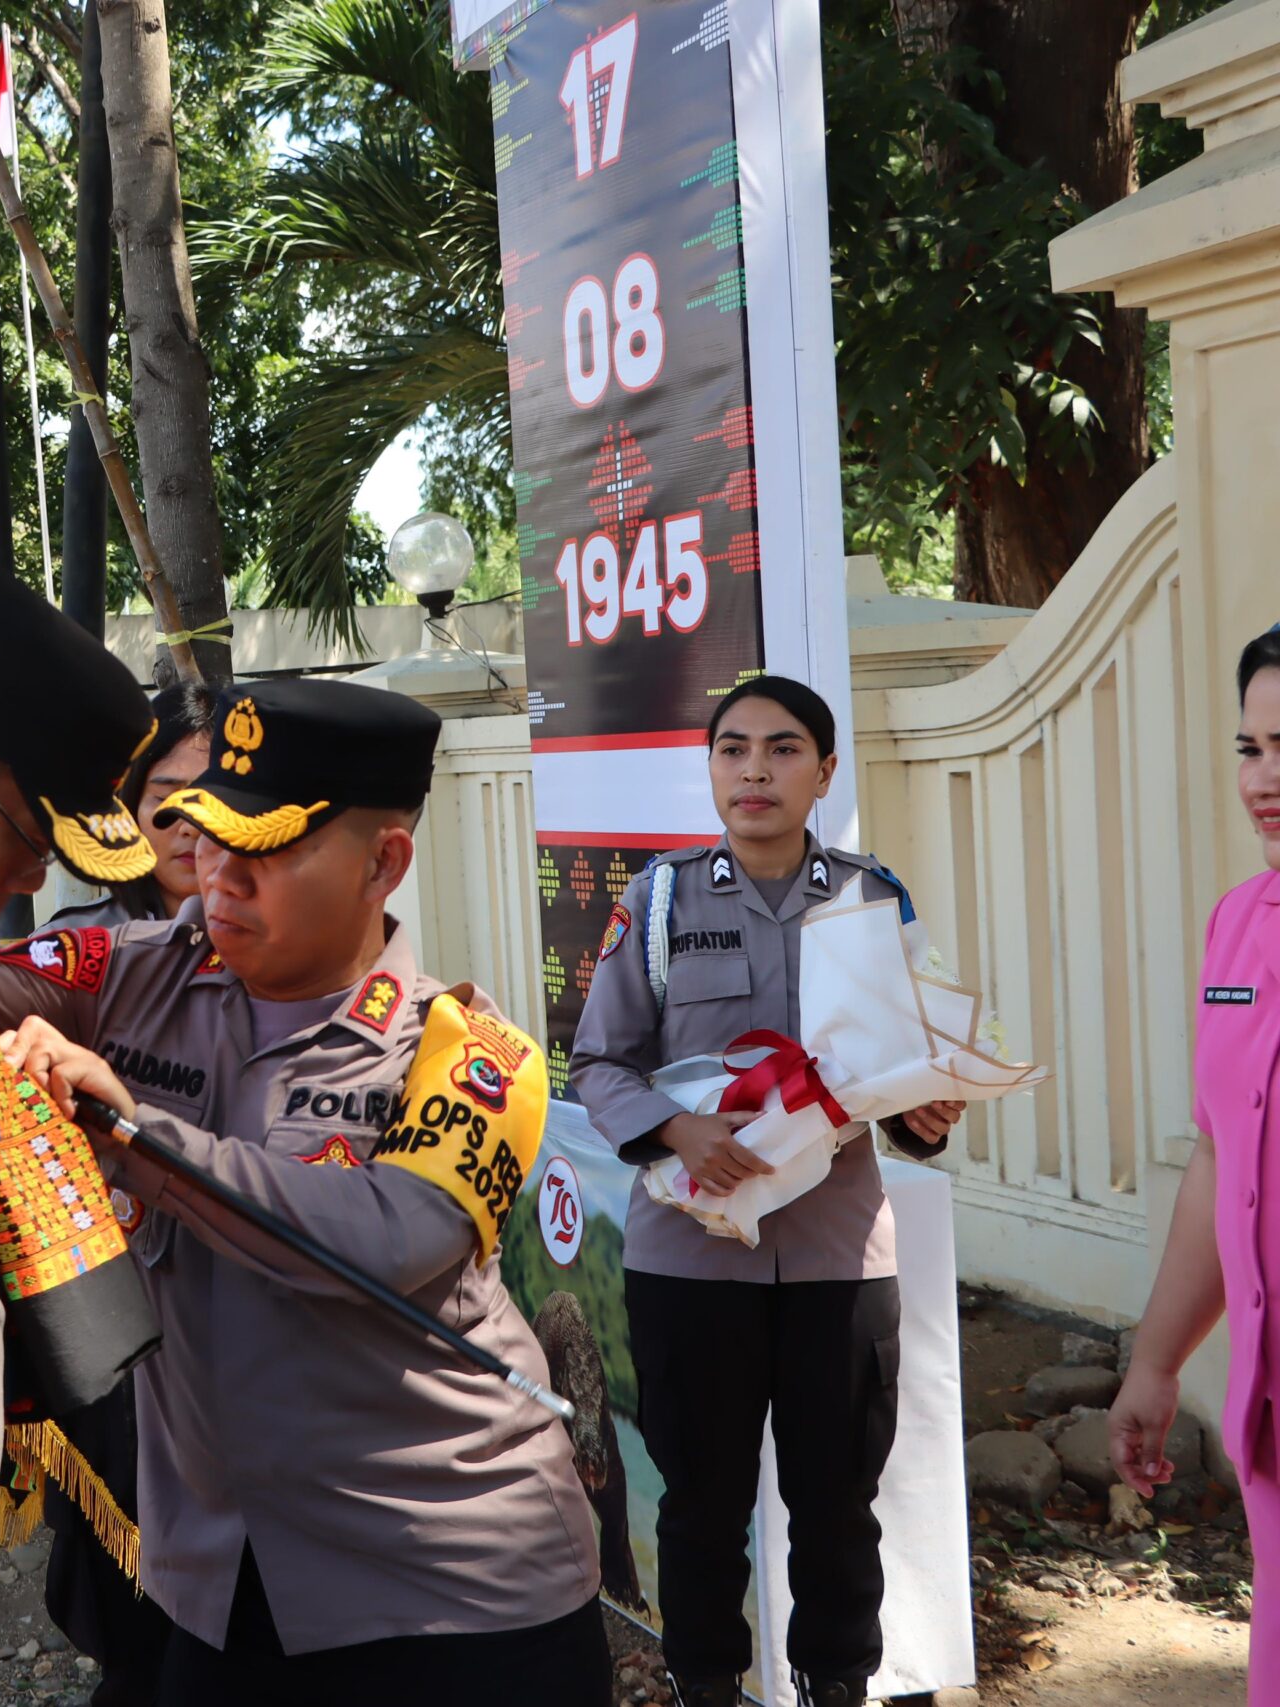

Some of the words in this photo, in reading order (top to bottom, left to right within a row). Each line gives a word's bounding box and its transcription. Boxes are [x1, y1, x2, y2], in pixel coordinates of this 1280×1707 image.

[559, 12, 639, 181] 17
[562, 251, 665, 409] 08
[554, 509, 709, 647] 1945
[420, 1094, 488, 1150] OPS
